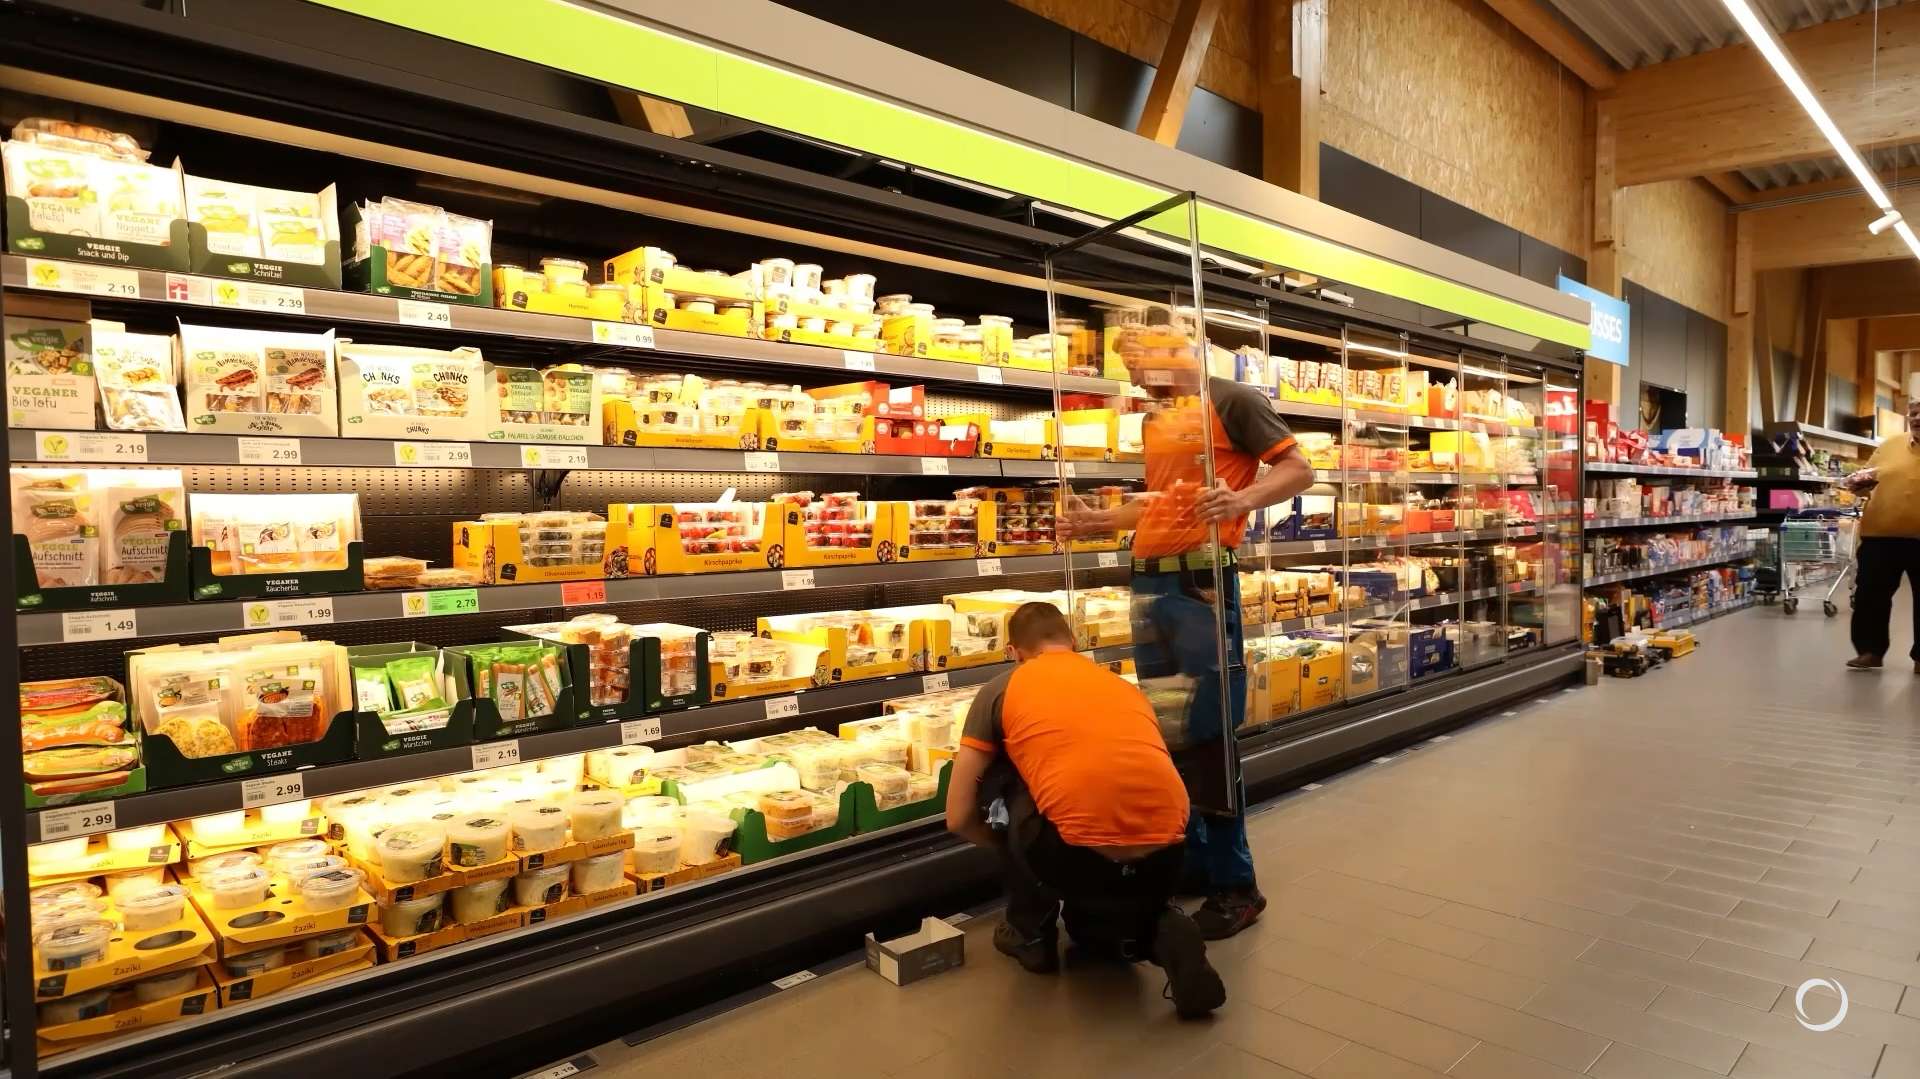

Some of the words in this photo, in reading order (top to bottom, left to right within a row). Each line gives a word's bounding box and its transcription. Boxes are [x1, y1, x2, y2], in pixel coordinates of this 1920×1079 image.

[77, 247, 100, 258] Snack
[101, 251, 116, 260] und
[117, 251, 130, 263] Dip
[108, 283, 136, 294] 2.19
[278, 297, 303, 309] 2.39
[427, 312, 449, 322] 2.49
[12, 386, 79, 398] VEGANER
[12, 396, 30, 409] Bio
[33, 397, 57, 409] Tofu
[115, 444, 145, 454] 2.19
[272, 450, 298, 459] 2.99
[448, 451, 469, 460] 2.99
[568, 456, 586, 464] 2.19
[32, 551, 85, 561] Aufschnitt
[704, 558, 743, 567] Kirschpaprika
[456, 599, 477, 609] 2.79
[308, 609, 331, 619] 1.99
[105, 620, 134, 632] 1.49
[643, 726, 660, 736] 1.69
[261, 750, 293, 760] VEGANE
[497, 749, 517, 760] 2.19
[267, 758, 288, 767] Steaks
[276, 783, 301, 796] 2.99
[82, 813, 112, 828] 2.99
[293, 921, 317, 933] Zaziki
[113, 962, 142, 976] Zaziki
[292, 967, 315, 979] Zaziki
[115, 1016, 142, 1029] Zaziki
